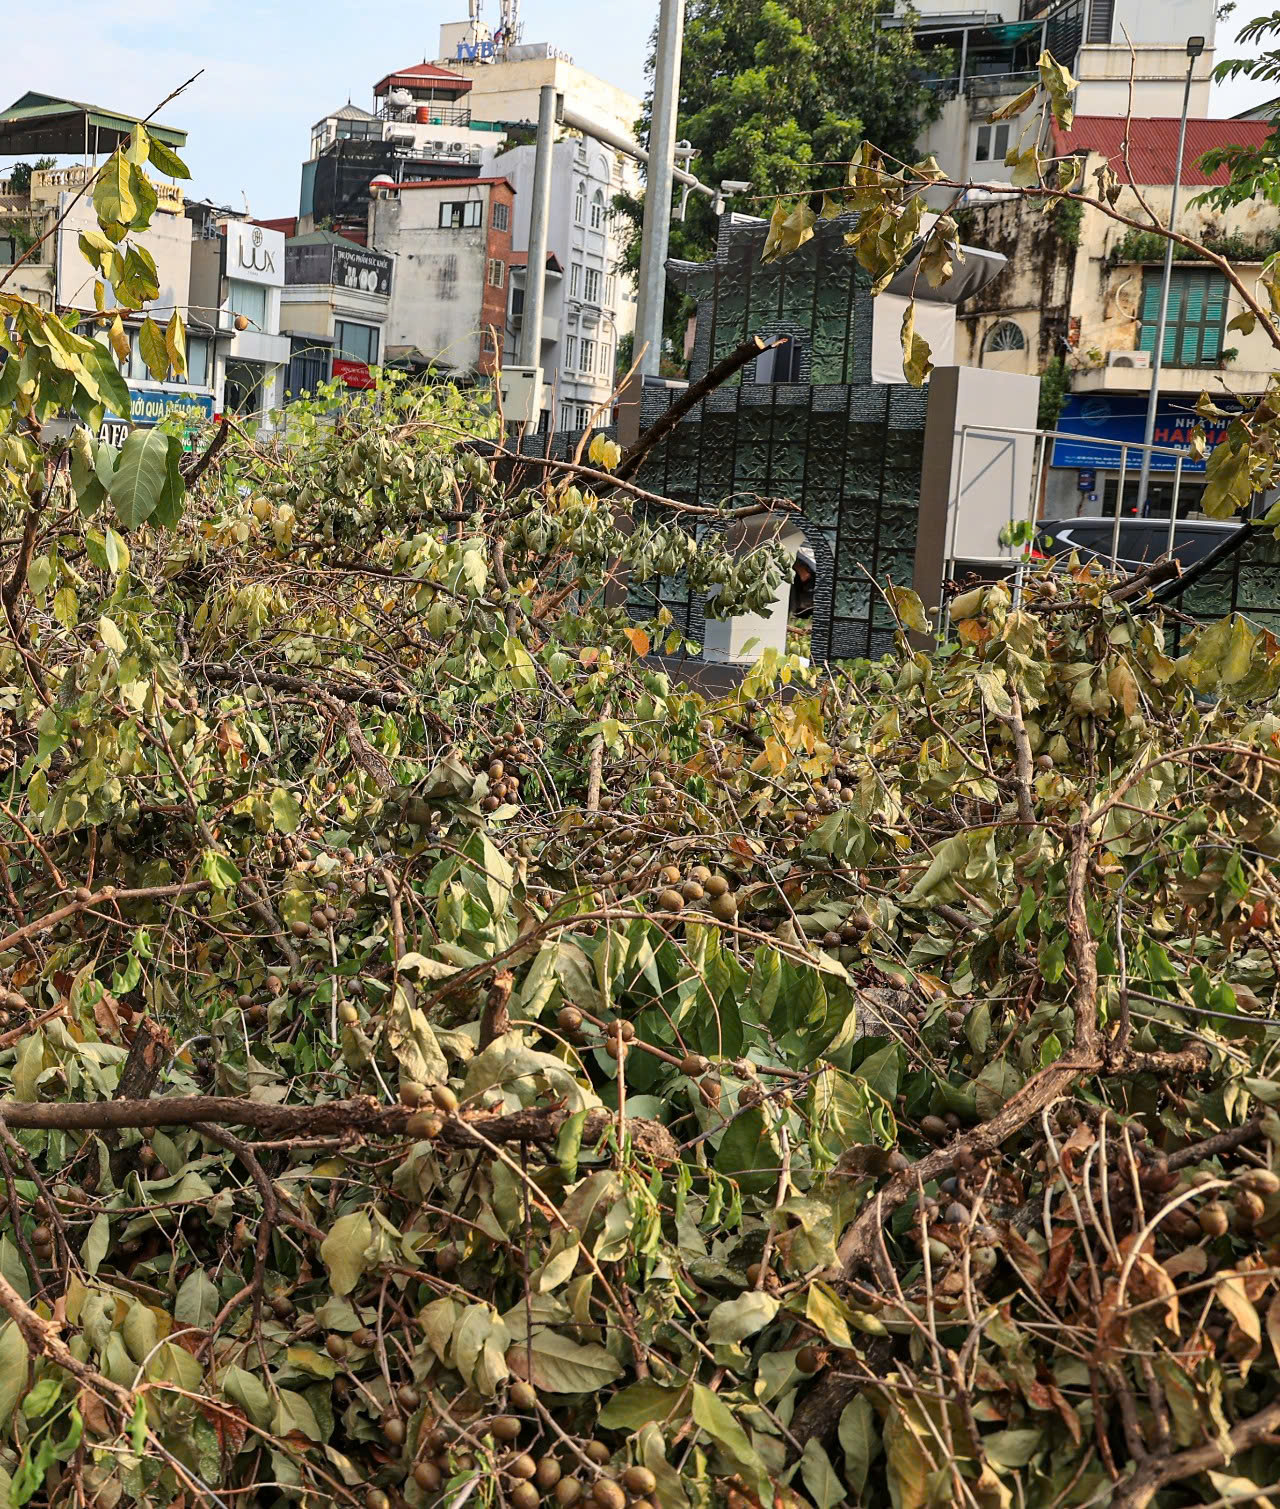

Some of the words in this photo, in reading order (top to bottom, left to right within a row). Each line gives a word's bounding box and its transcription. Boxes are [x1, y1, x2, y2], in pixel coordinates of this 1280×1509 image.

[130, 398, 144, 416] IỚI
[145, 399, 164, 418] QUÀ
[1175, 417, 1206, 428] NHÀ
